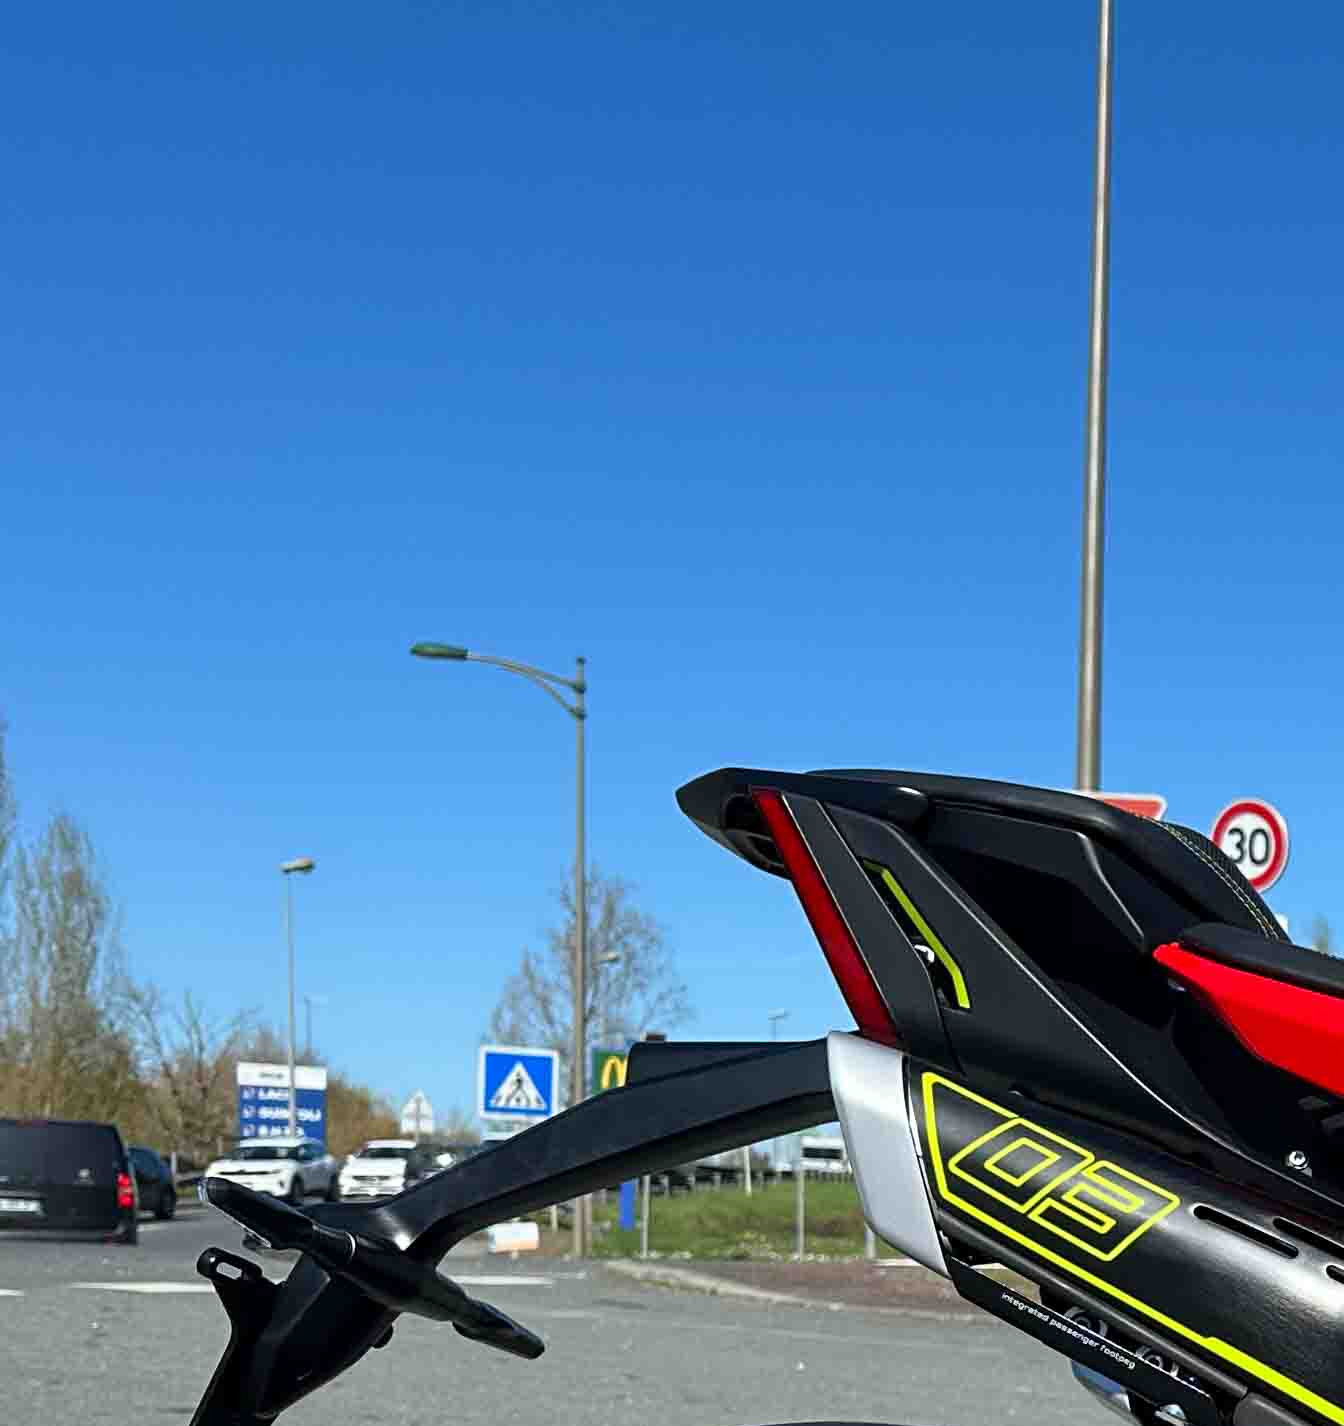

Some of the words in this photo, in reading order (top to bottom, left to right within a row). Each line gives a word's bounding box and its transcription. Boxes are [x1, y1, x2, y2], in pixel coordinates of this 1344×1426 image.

[1226, 827, 1270, 865] 30
[948, 1117, 1181, 1262] 03
[1001, 1292, 1050, 1322] integrated
[1049, 1318, 1100, 1349] passenger
[1099, 1343, 1136, 1370] footpeg
